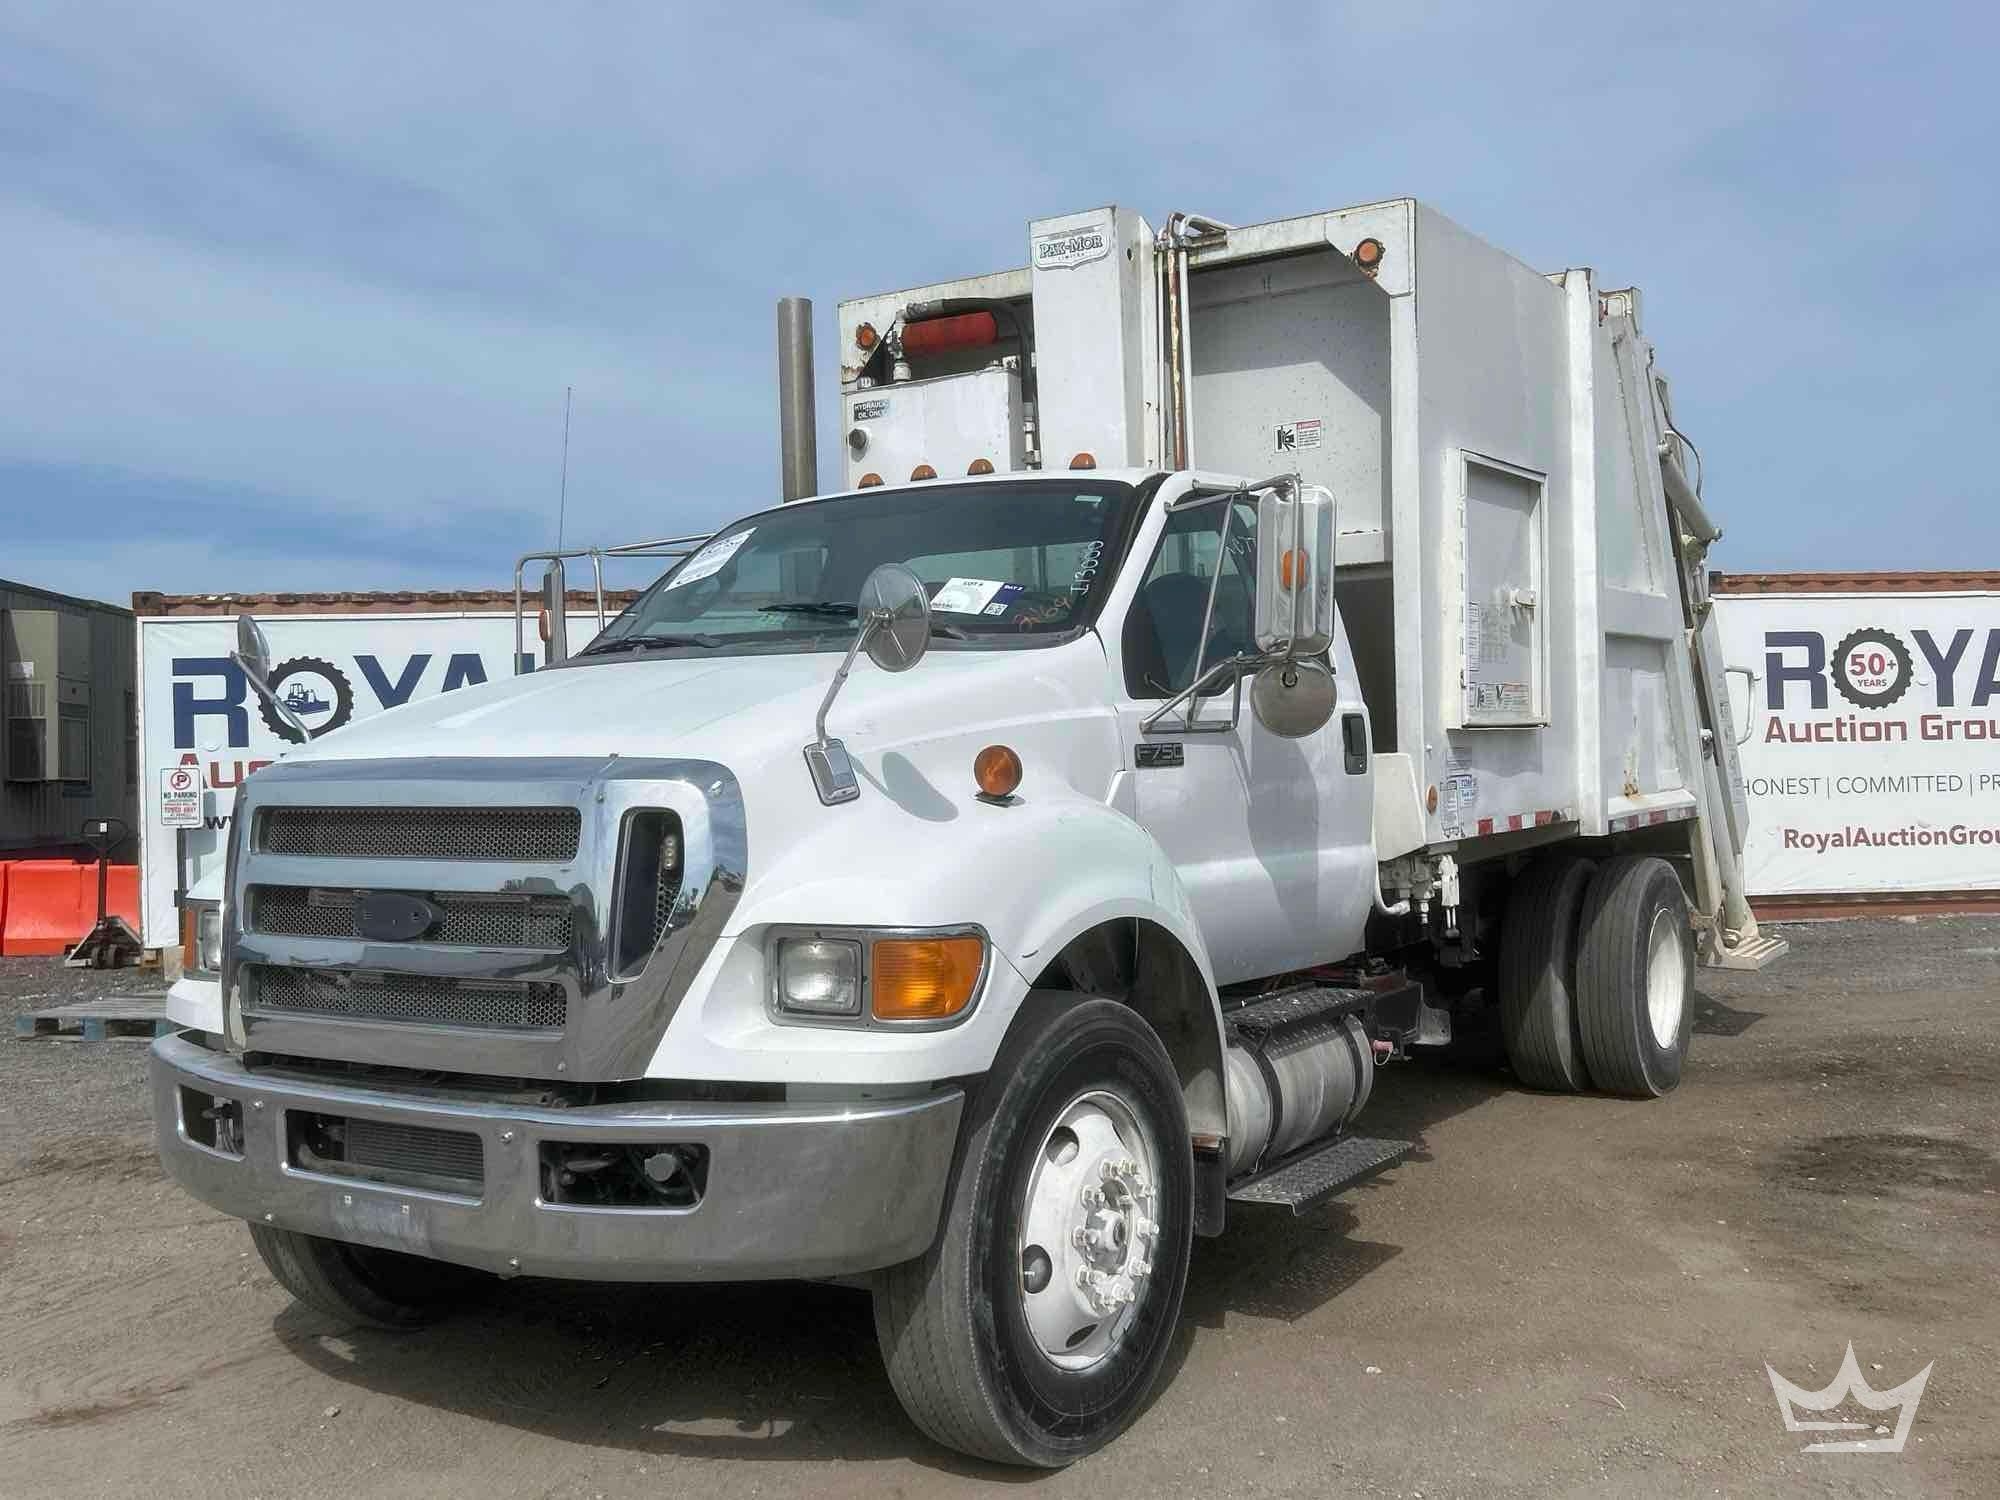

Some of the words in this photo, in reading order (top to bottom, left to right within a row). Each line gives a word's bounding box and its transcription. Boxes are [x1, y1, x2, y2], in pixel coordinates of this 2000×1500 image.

[1040, 235, 1103, 258] PAK-MOR
[1849, 653, 1896, 676] 50+
[172, 653, 536, 749] ROY
[1765, 715, 1907, 743] Auction
[163, 791, 171, 799] NO
[174, 791, 197, 799] PARKING
[1836, 774, 1963, 794] COMMITTED
